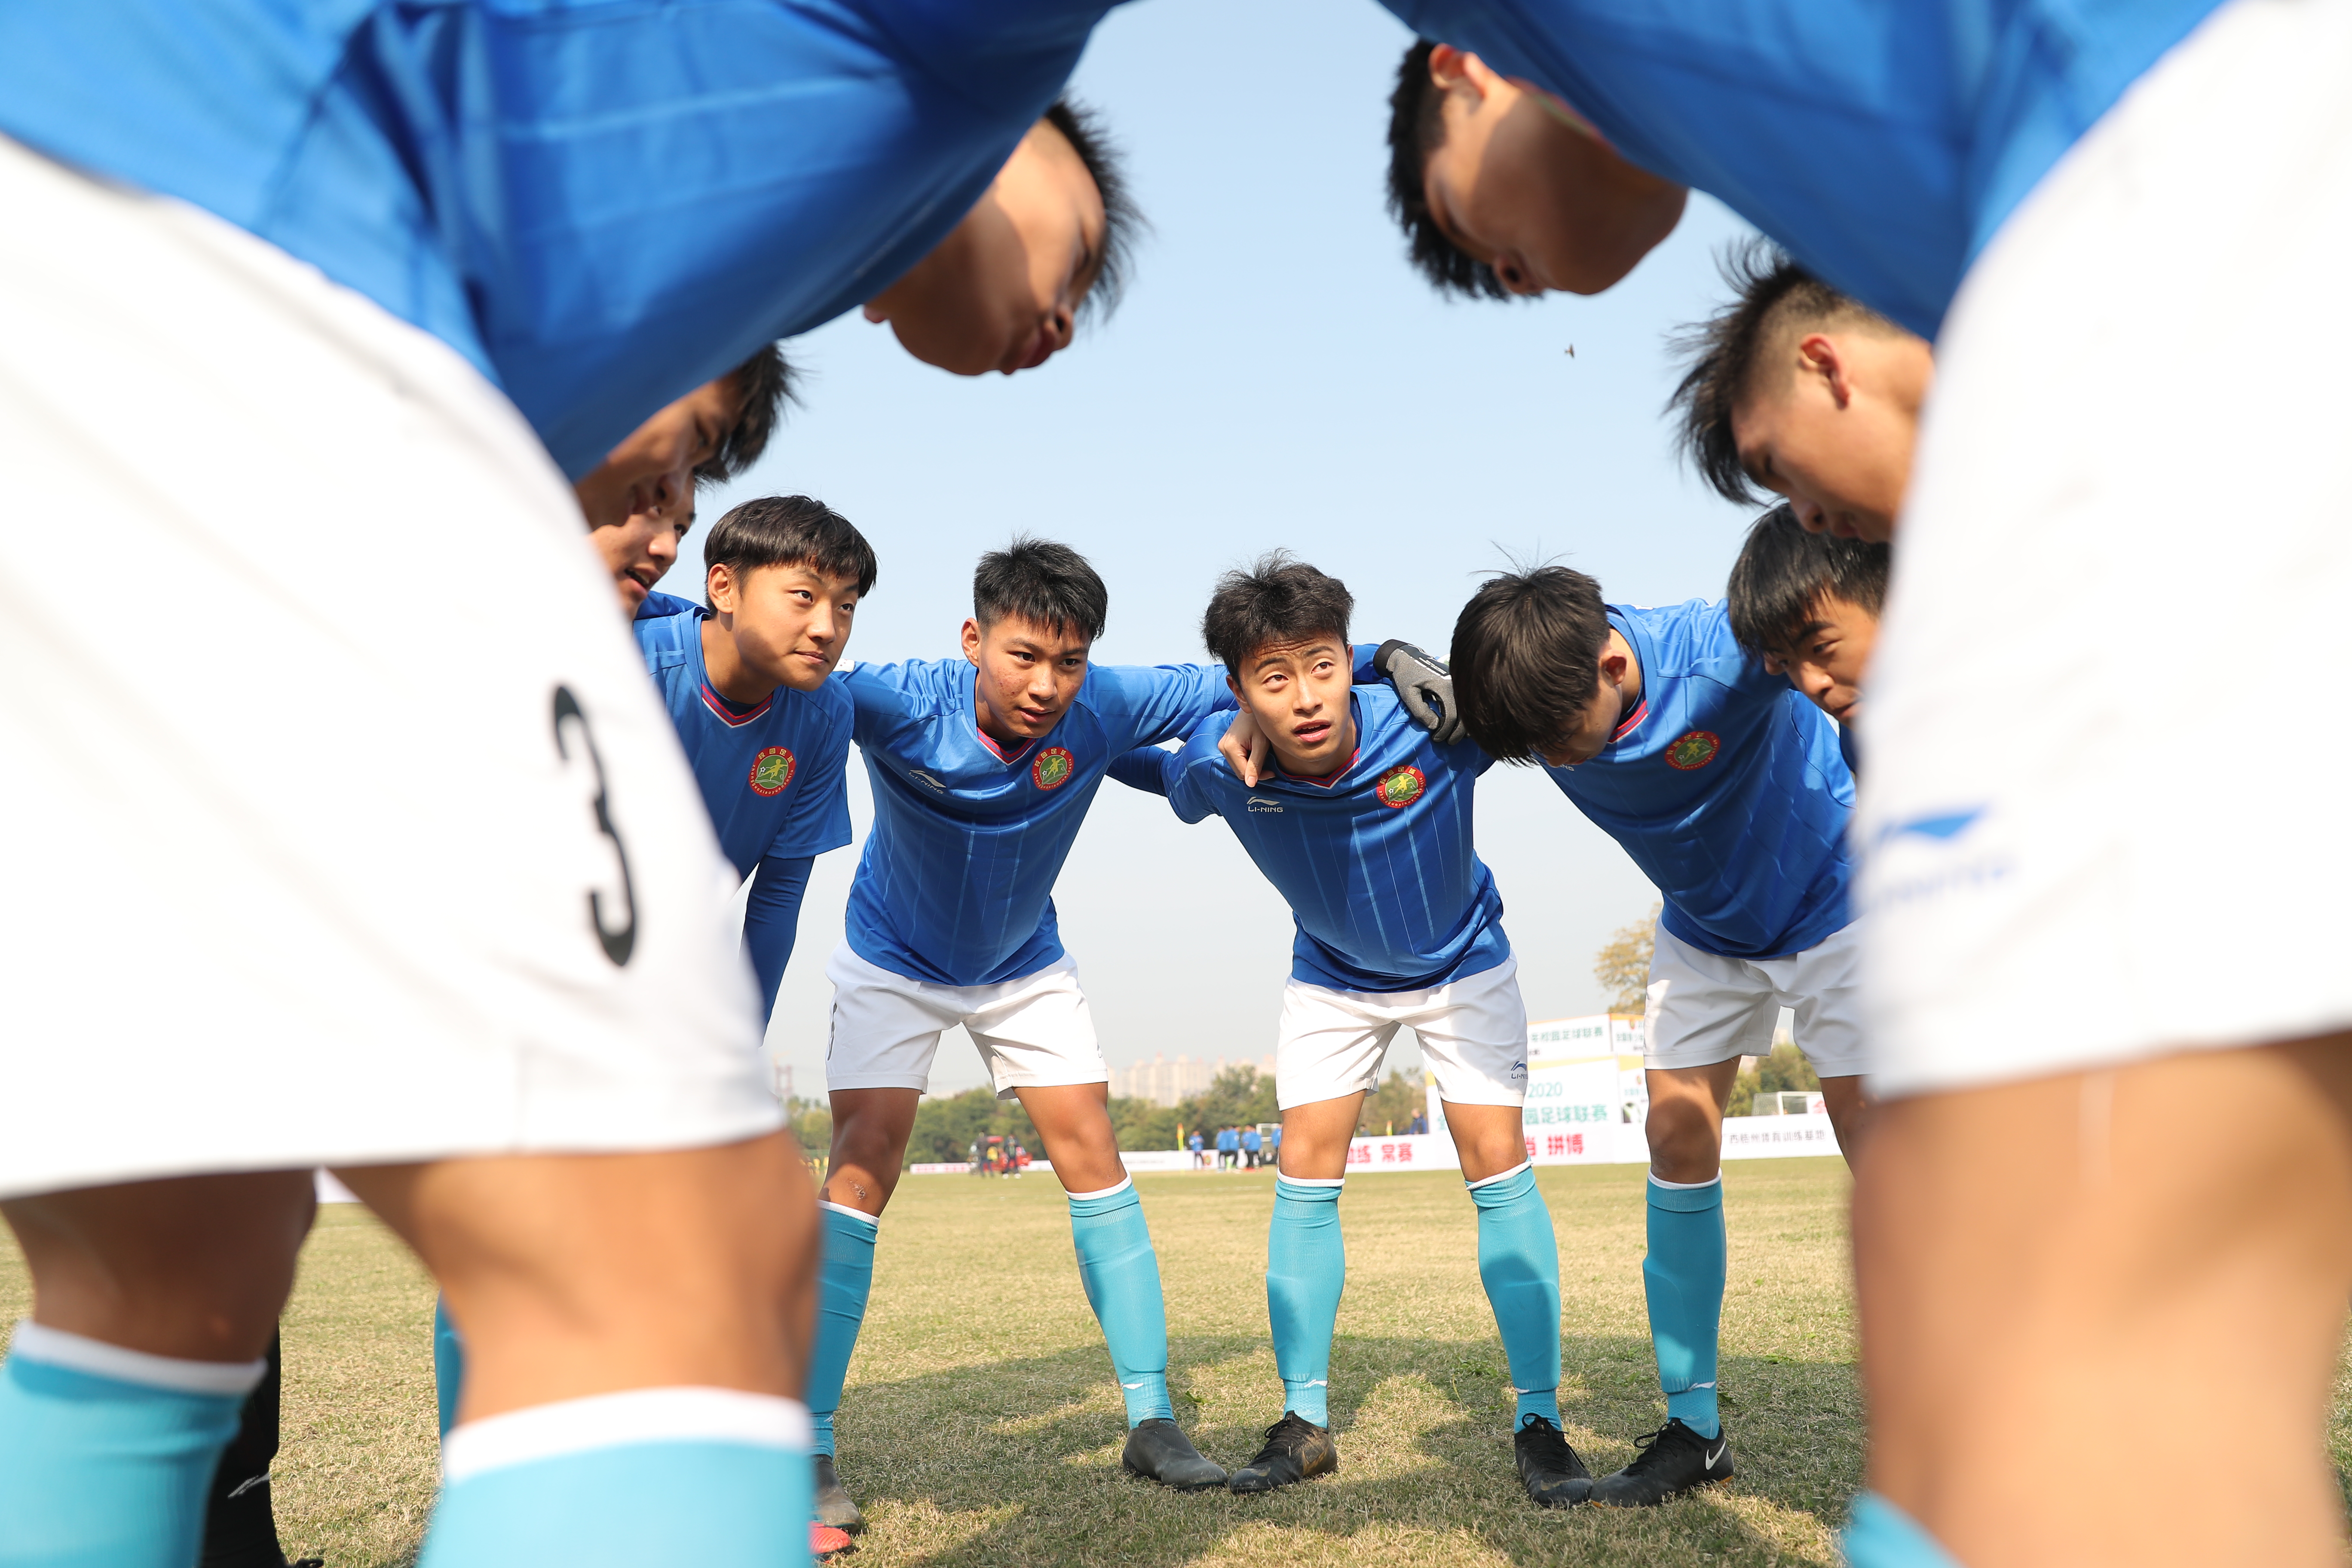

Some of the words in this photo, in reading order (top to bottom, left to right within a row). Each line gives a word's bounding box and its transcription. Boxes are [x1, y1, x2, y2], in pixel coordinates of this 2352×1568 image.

[758, 748, 793, 763] 校园足球
[1034, 748, 1066, 767] 校园足球
[908, 772, 944, 794] LI-NING
[1380, 766, 1416, 784] 校园足球
[554, 686, 636, 967] 3
[1528, 1082, 1562, 1098] 2020
[1381, 1143, 1412, 1162] 常赛
